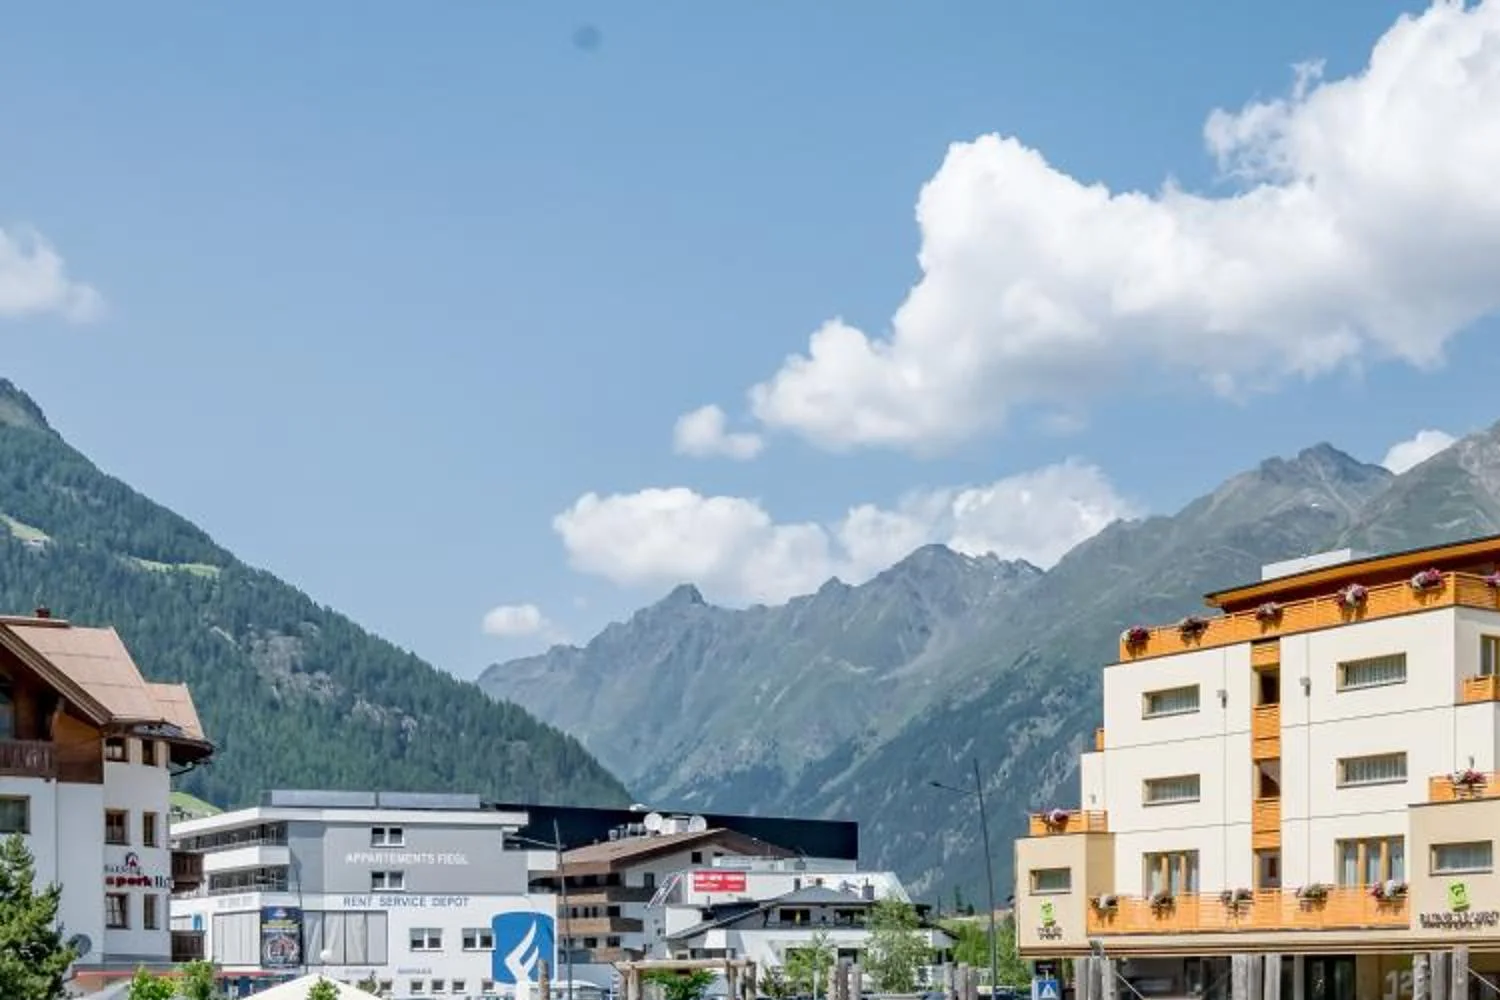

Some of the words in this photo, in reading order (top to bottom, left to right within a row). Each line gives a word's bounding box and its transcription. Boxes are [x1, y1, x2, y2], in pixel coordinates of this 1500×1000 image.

[345, 852, 435, 865] APPARTEMENTS
[343, 895, 372, 907] RENT
[379, 895, 426, 907] SERVICE
[431, 895, 469, 907] DEPOT
